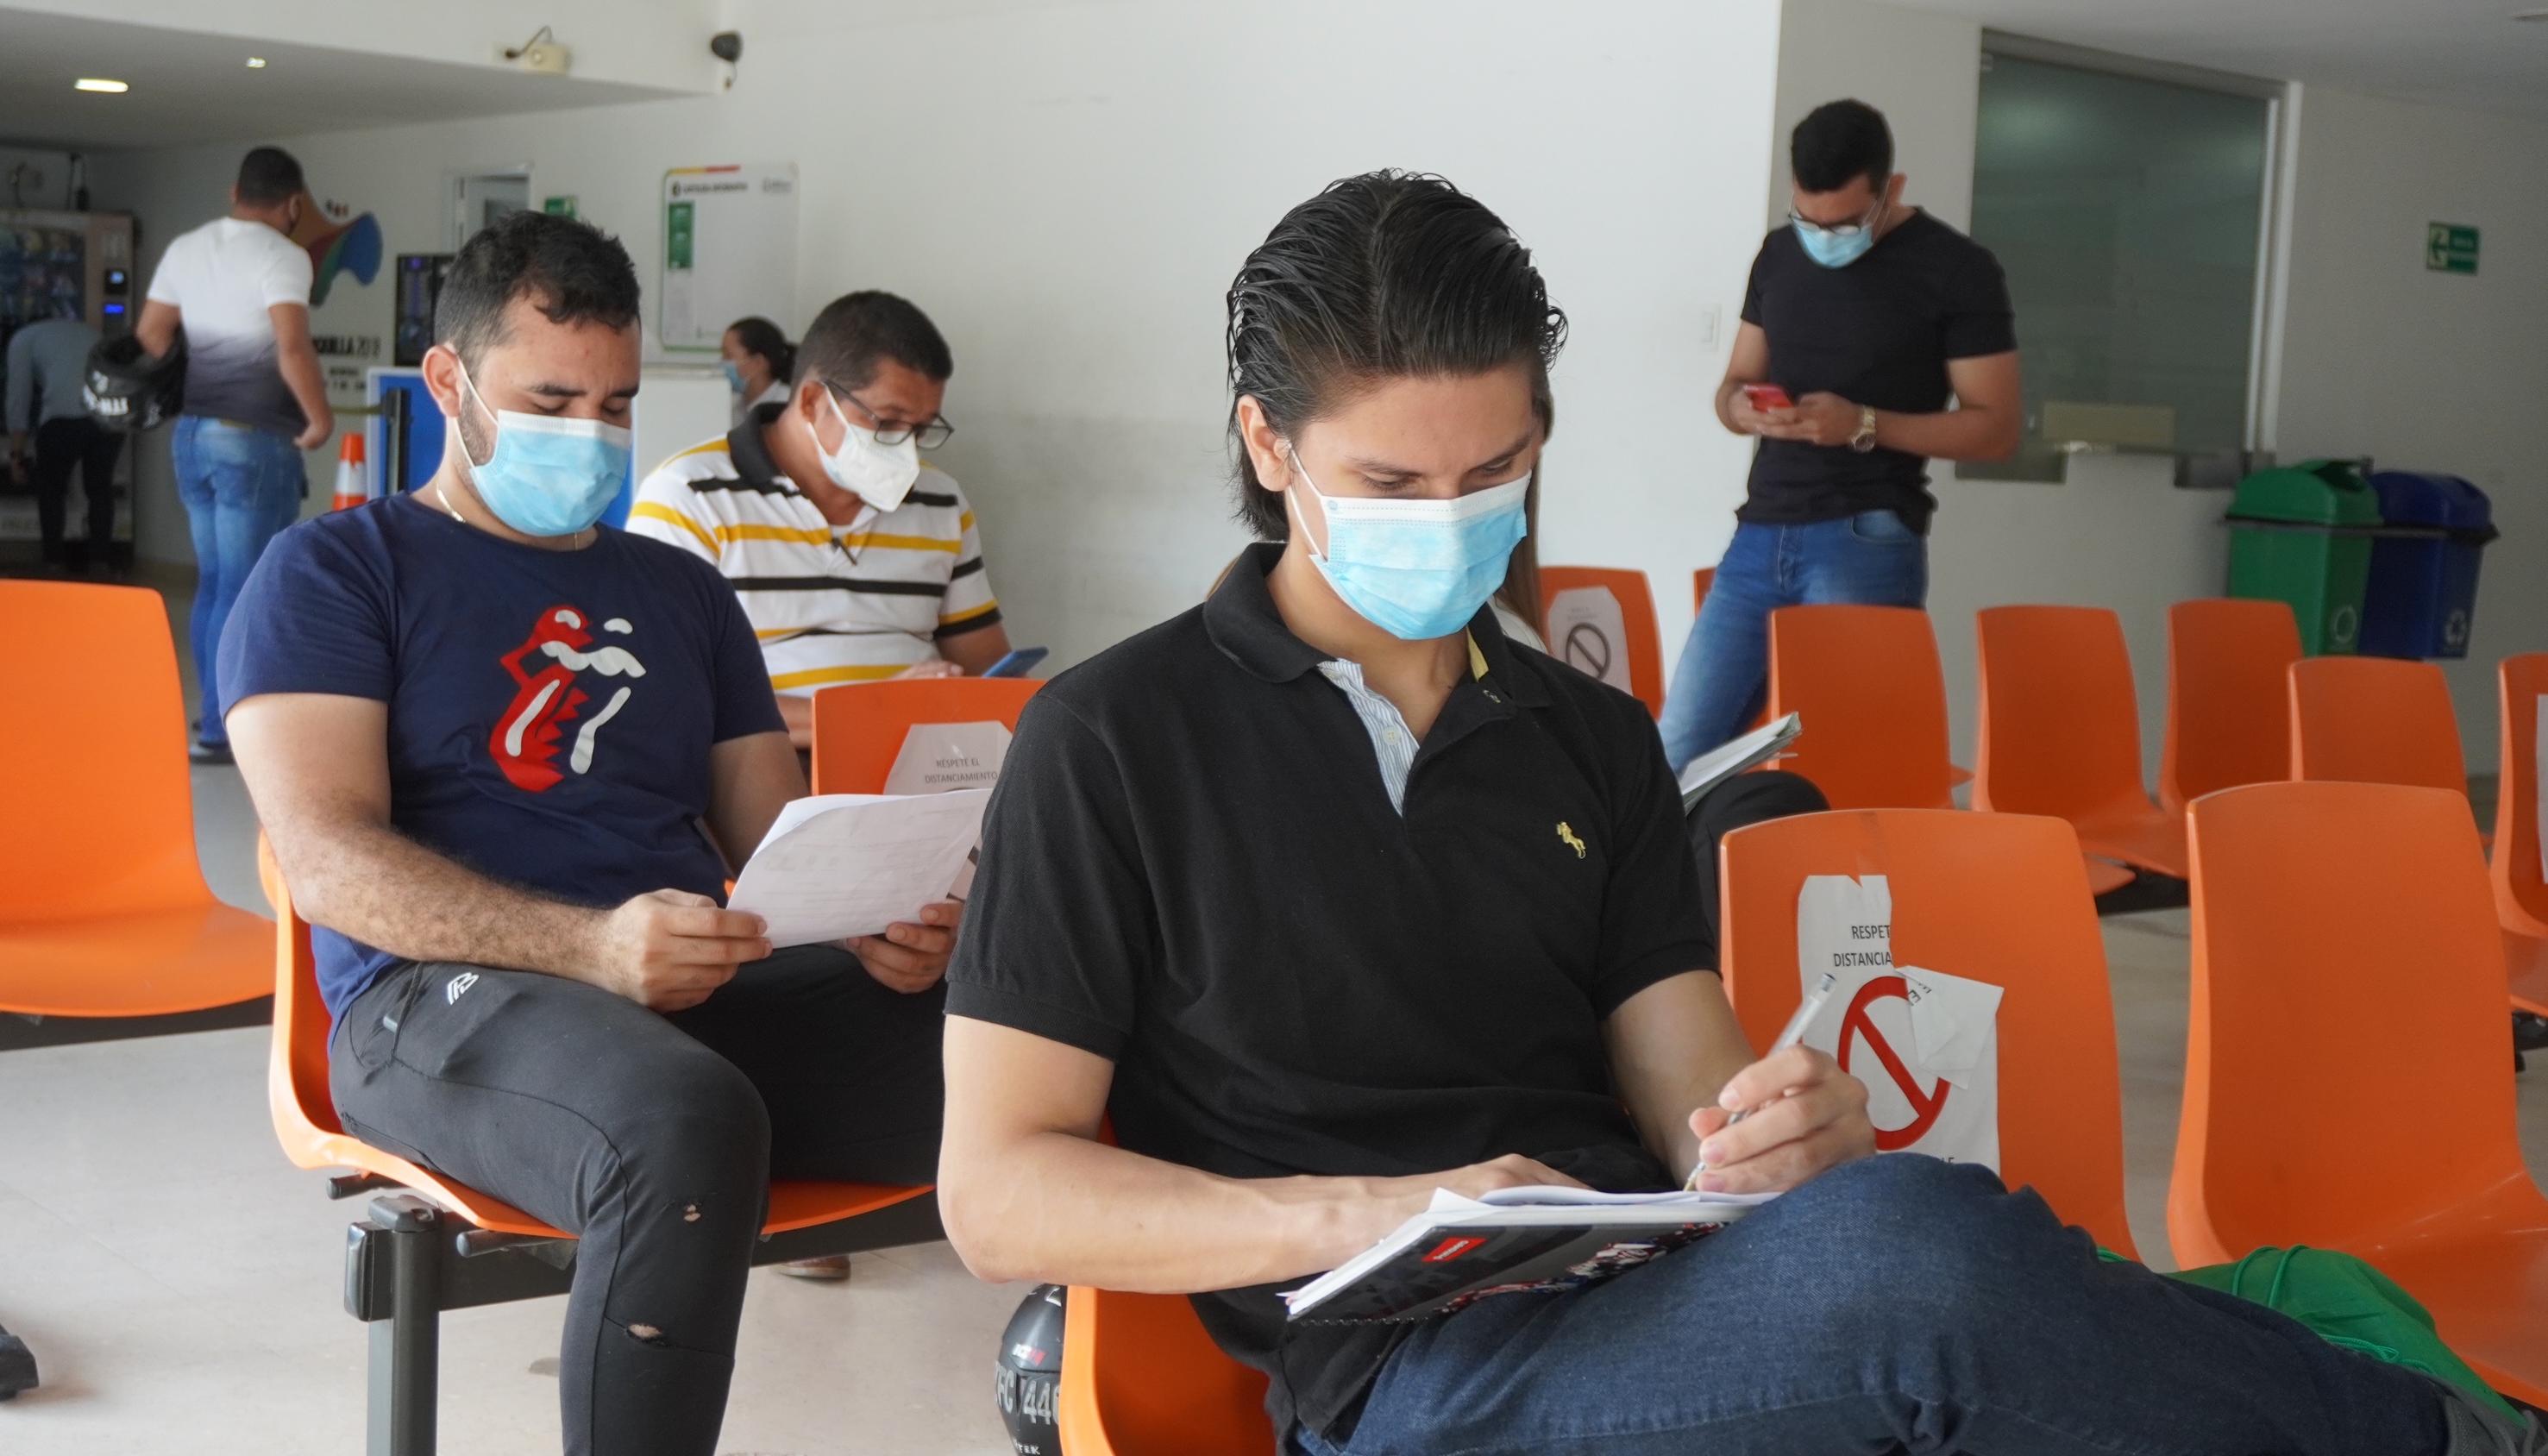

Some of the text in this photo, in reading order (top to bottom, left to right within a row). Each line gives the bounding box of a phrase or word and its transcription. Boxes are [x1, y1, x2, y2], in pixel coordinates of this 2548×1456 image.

[937, 758, 980, 768] RESPETE EL
[925, 771, 998, 783] DISTANCIAMIENTO
[1851, 925, 1891, 939] RESPET
[1833, 951, 1892, 967] DISTANCIA
